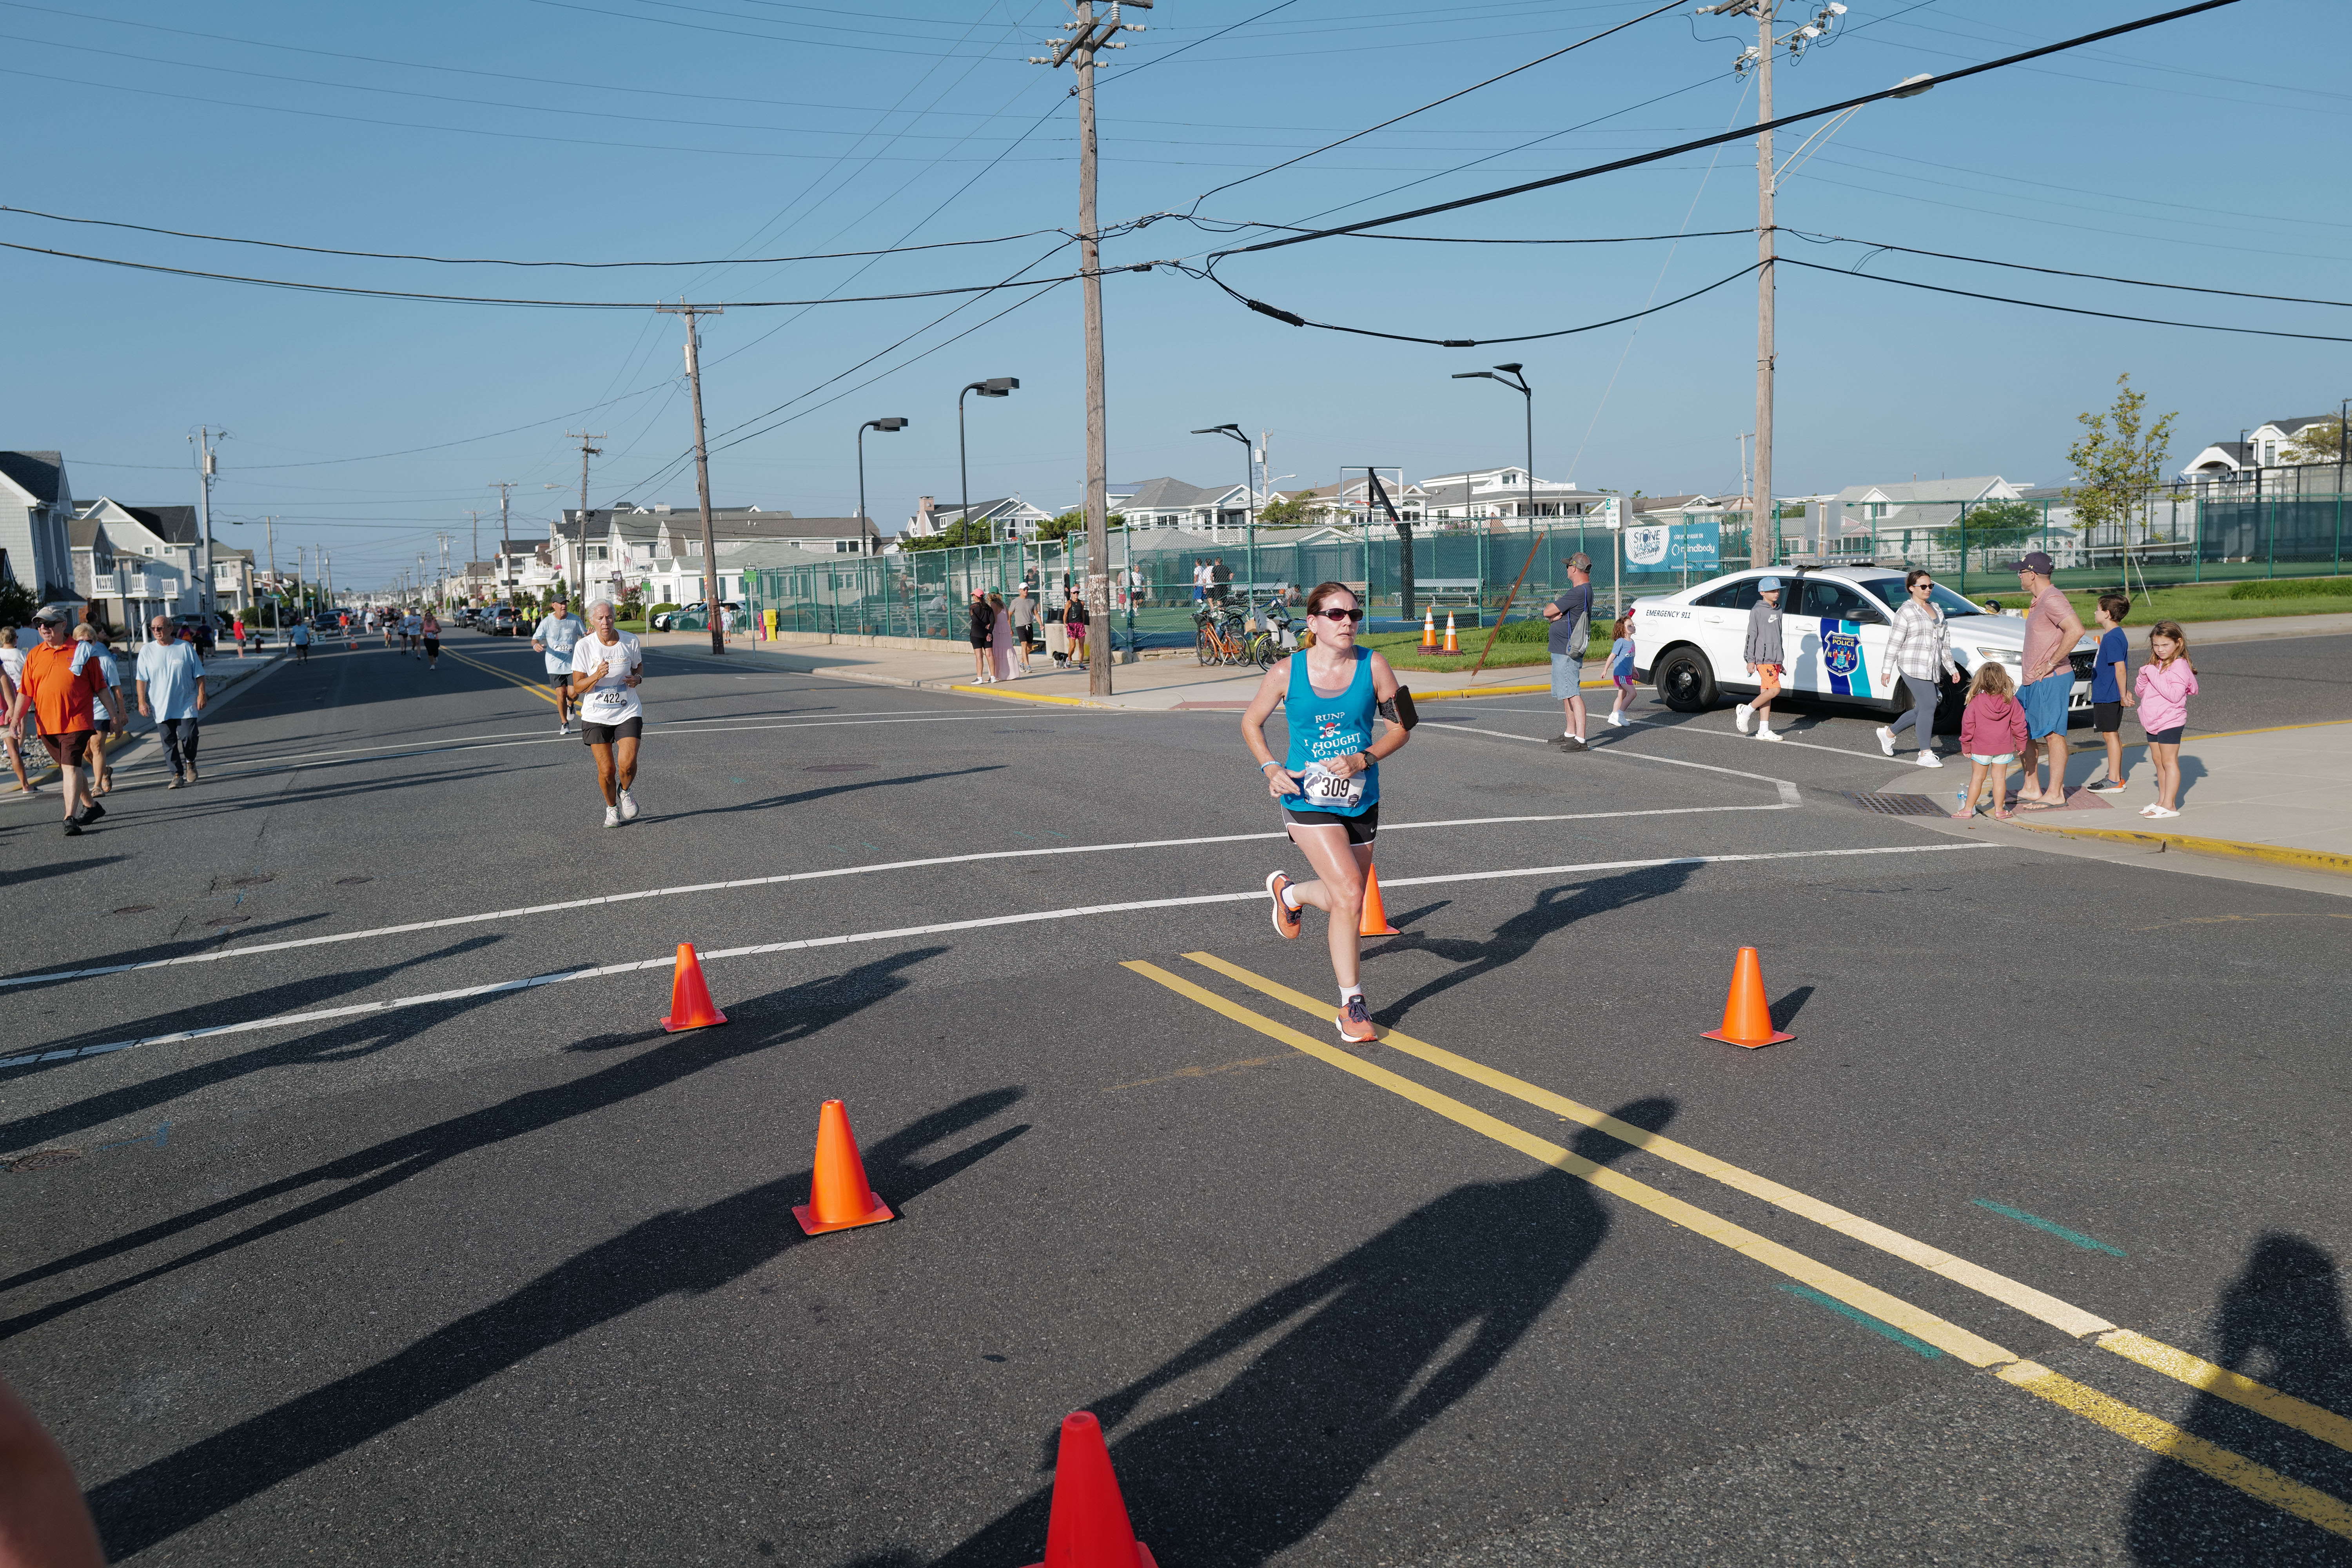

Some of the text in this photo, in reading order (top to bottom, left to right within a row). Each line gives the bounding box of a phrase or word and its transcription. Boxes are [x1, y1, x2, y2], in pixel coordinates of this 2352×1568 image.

[1606, 500, 1610, 508] 3
[603, 693, 620, 703] 422
[1314, 712, 1345, 724] RUN?
[1334, 746, 1357, 756] SAID
[1321, 777, 1350, 797] 309
